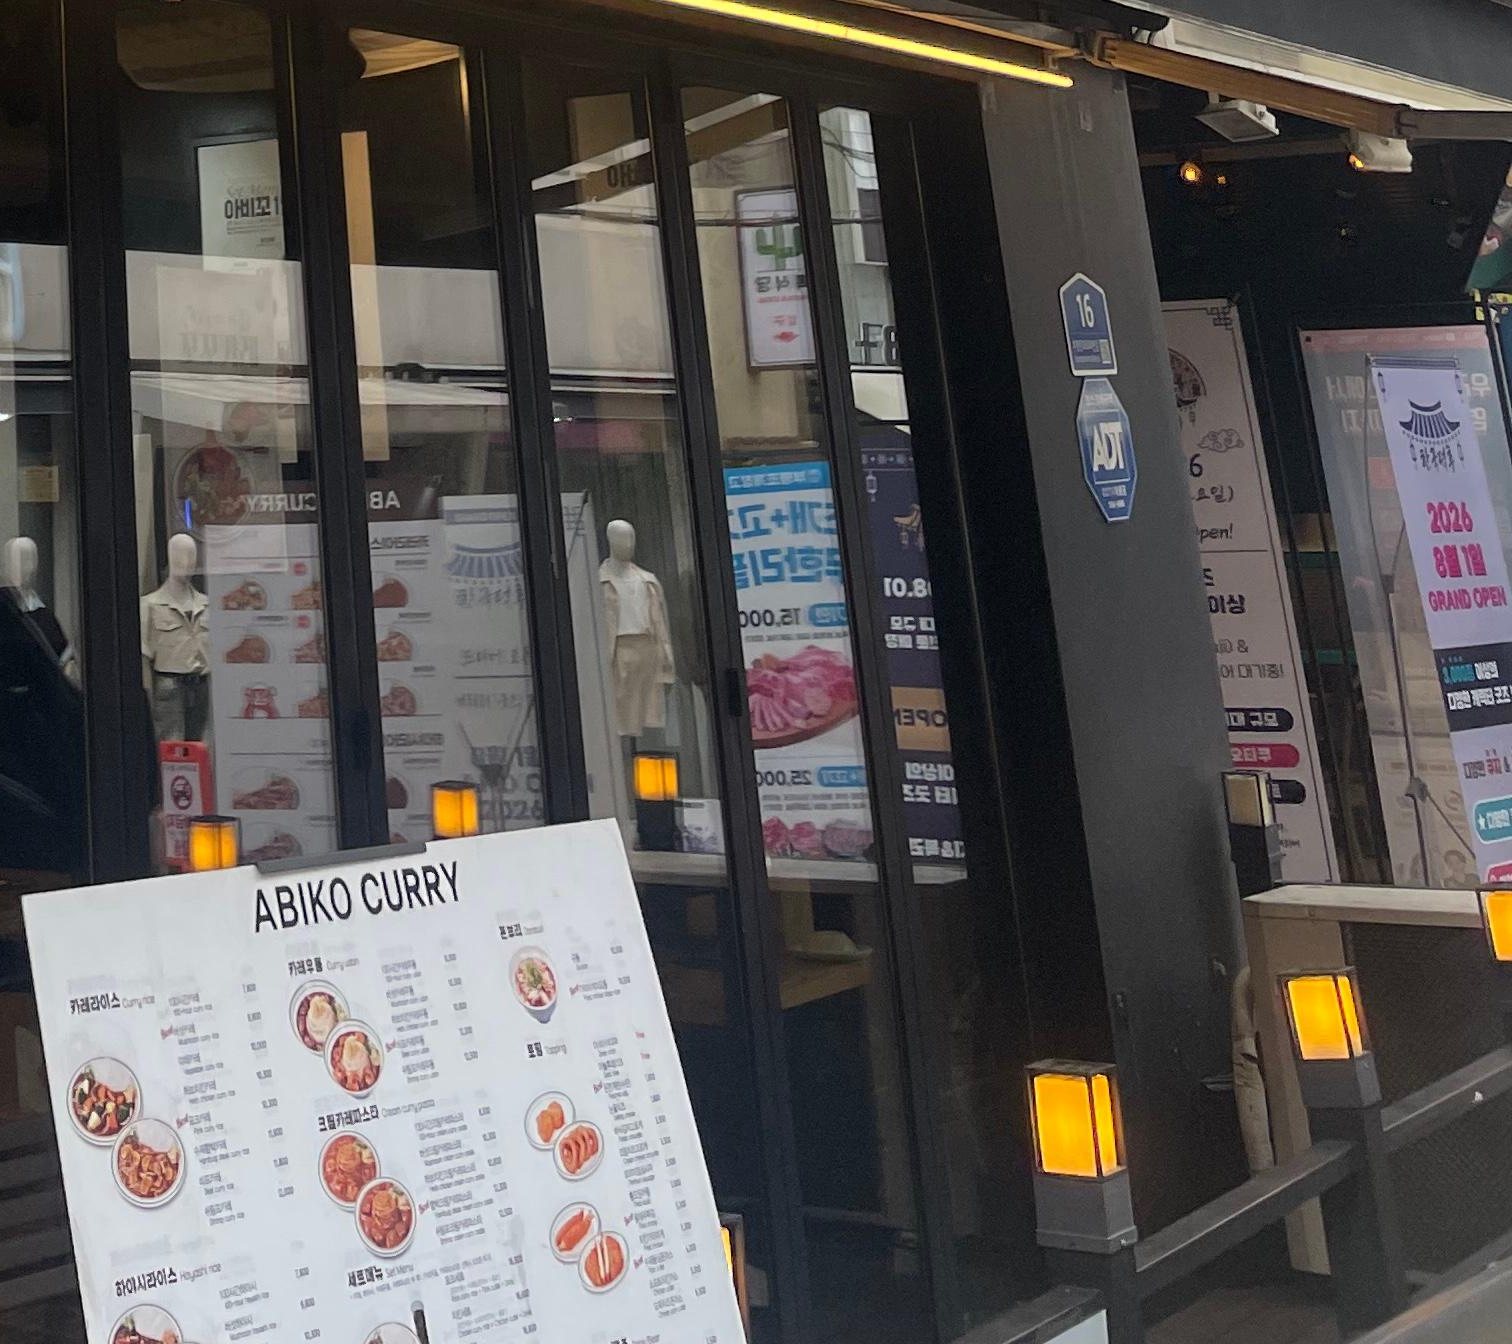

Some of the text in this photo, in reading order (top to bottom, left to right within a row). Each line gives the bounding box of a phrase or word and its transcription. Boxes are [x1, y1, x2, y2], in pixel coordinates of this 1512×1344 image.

[1075, 293, 1095, 328] 16
[1092, 421, 1125, 473] ADT
[1426, 501, 1473, 533] 2026
[1196, 522, 1234, 544] pen!
[1428, 585, 1507, 612] GRAND OPEN
[254, 861, 461, 933] ABIKO CURRY
[70, 992, 121, 1016] 카레라이스
[318, 1104, 380, 1132] 크림카레파스타
[114, 1267, 178, 1297] 하이시라이스
